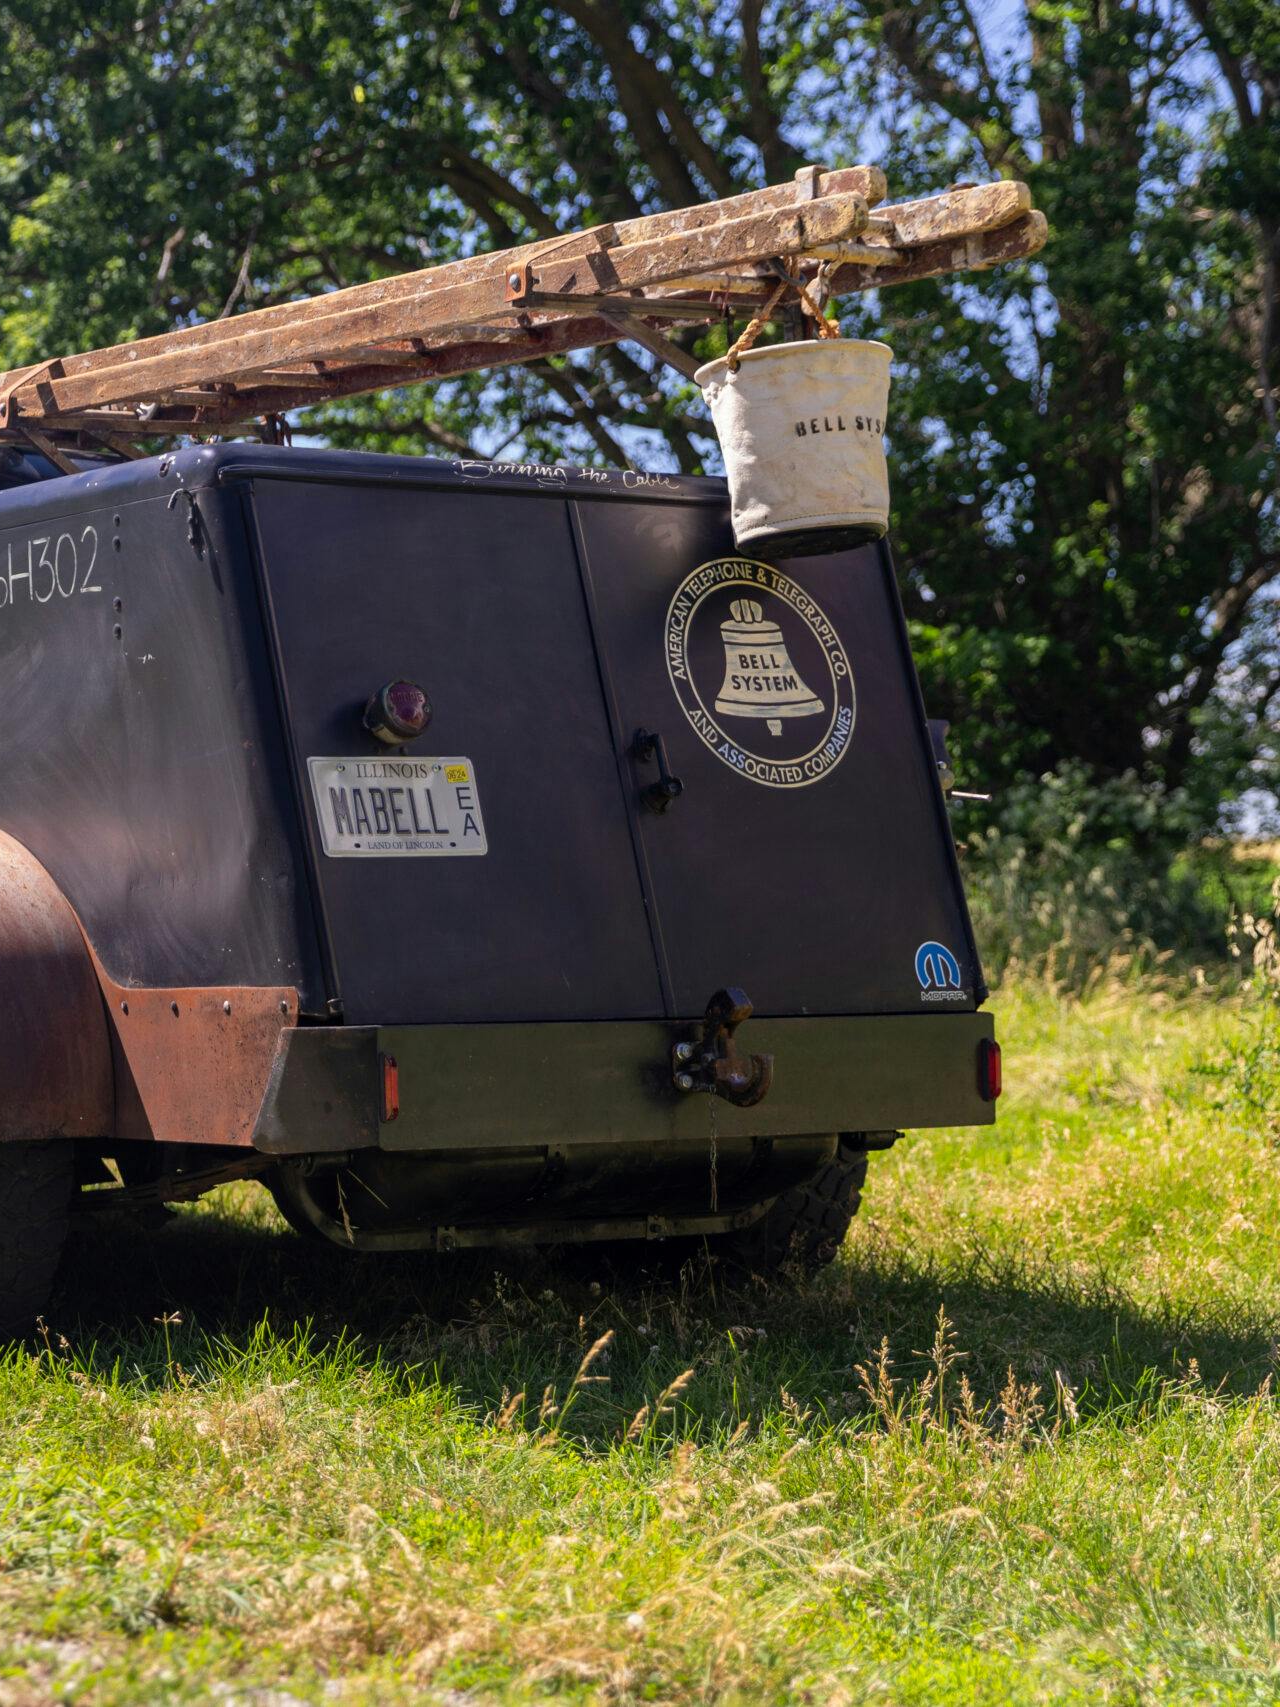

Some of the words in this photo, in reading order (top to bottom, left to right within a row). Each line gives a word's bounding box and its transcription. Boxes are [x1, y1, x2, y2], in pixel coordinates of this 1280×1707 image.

[795, 415, 846, 437] BELL
[855, 415, 884, 435] SYS
[577, 468, 612, 484] the
[669, 594, 692, 681] AMERICAN
[684, 563, 753, 602] TELEPHONE
[756, 567, 768, 584] &
[771, 574, 837, 648] TELEGRAPH
[831, 649, 848, 681] CO.
[738, 653, 781, 670] BELL
[732, 674, 799, 692] SYSTEM
[688, 708, 719, 745] AND
[718, 742, 803, 783] ASSOCIATED
[804, 705, 852, 778] COMPANIES
[356, 763, 428, 778] ILLINOIS
[329, 786, 450, 836] MABELL
[368, 841, 391, 850] LAND
[393, 841, 404, 849] OF
[406, 840, 444, 849] LINCOLN
